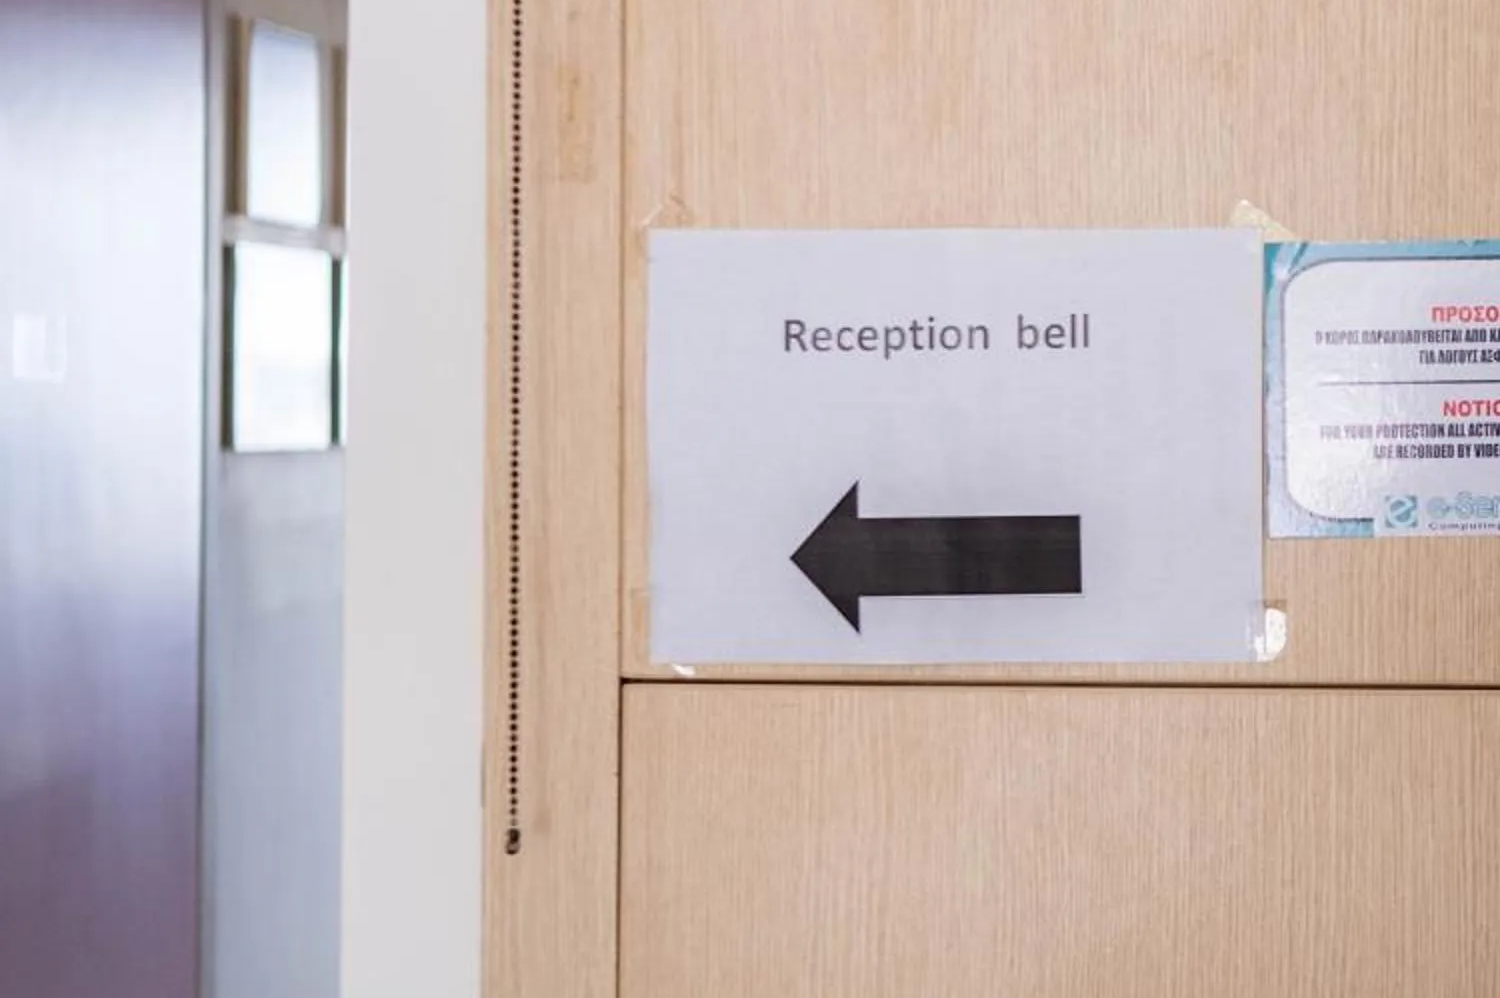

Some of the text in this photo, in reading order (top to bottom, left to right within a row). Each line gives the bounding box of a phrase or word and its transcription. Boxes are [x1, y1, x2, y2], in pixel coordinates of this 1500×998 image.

[783, 313, 1091, 359] Reception bell
[1375, 423, 1445, 439] PROTECTION
[1447, 422, 1466, 437] ALL
[1396, 443, 1455, 459] RECORDED
[1457, 443, 1472, 458] BY
